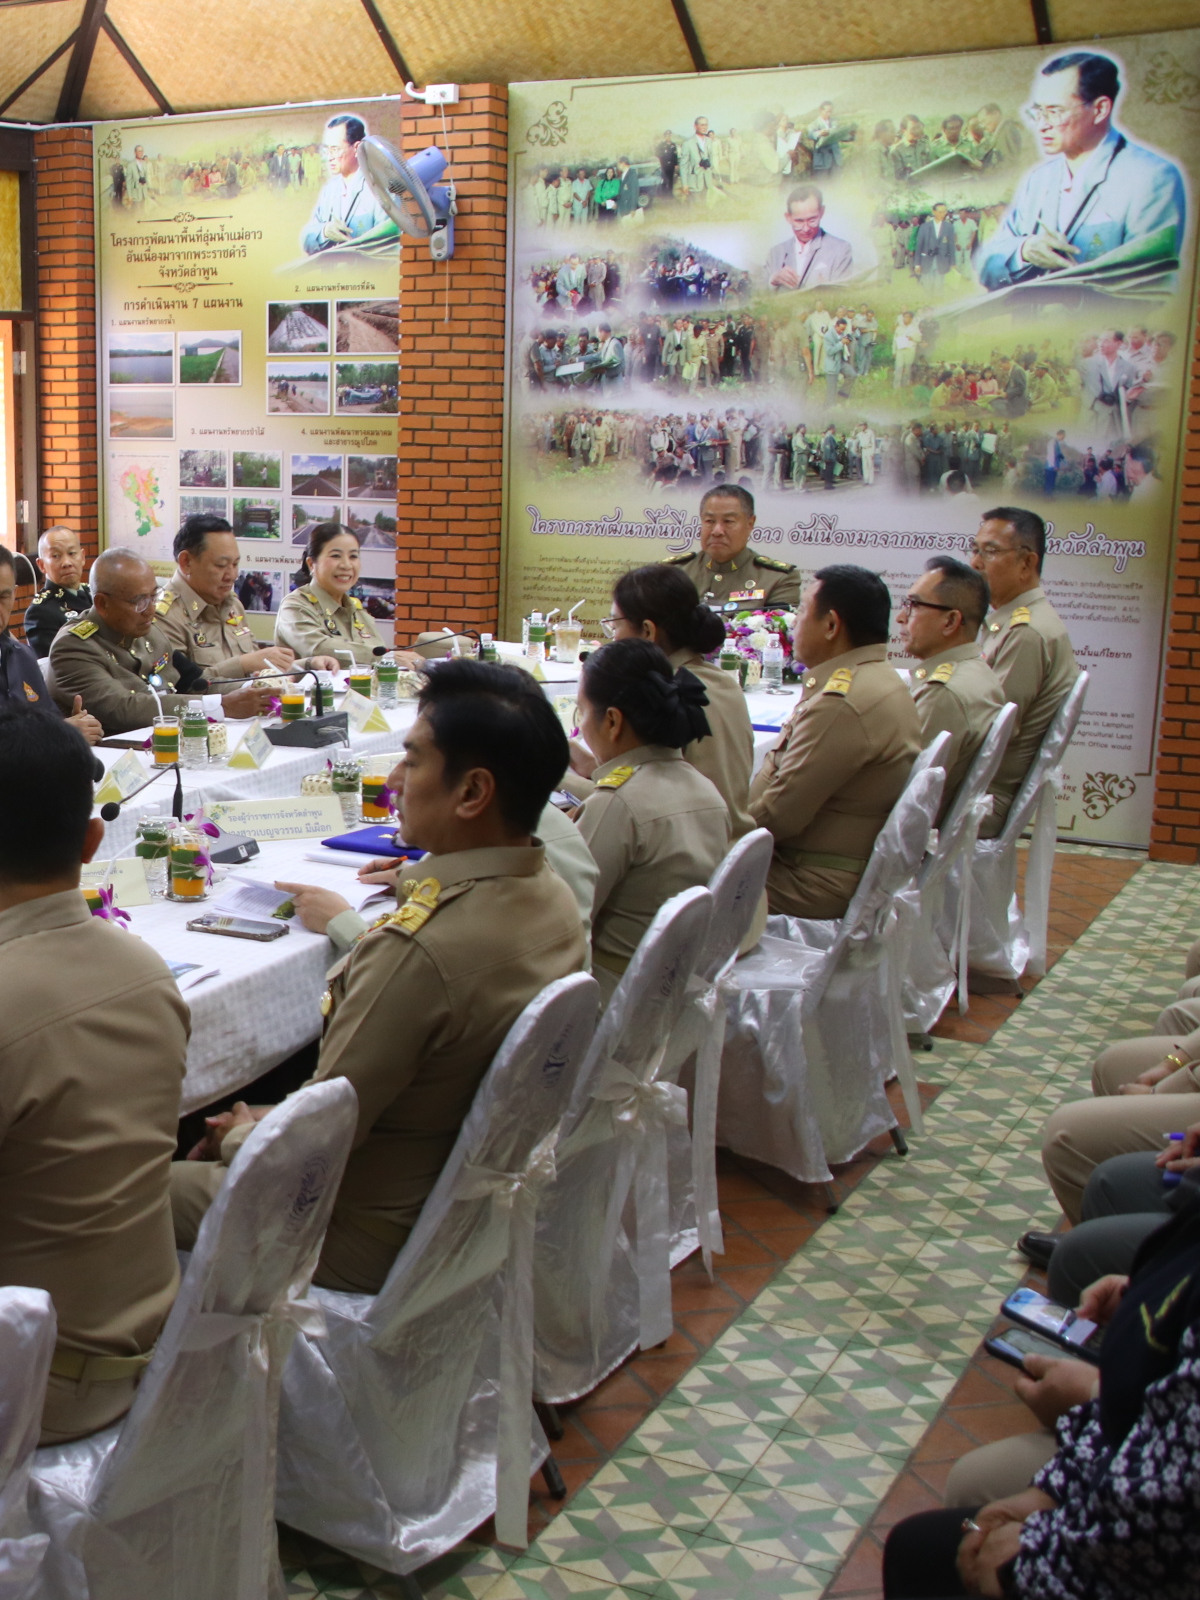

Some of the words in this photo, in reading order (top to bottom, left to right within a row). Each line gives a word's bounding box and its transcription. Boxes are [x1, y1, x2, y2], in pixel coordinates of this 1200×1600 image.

[110, 224, 263, 247] โครงการพัฒนาพื้นที่ลุ่มน้ำแม่อาว
[126, 244, 247, 263] อันเนื่องมาจากพระราชดำริ
[158, 264, 218, 280] จังหวัดลำพูน
[123, 297, 188, 311] การดำเนินงาน
[192, 298, 199, 309] 7
[203, 297, 244, 309] แผนงาน
[1080, 709, 1108, 717] sources
[1101, 721, 1134, 729] Lamphun
[1076, 730, 1114, 738] Agricultural
[1115, 732, 1133, 740] Land
[1111, 743, 1132, 751] would
[228, 808, 323, 824] รองผู้ว่าราชการจังหวัดลำพูน
[227, 826, 303, 838] างสาวเบญจวรรณ
[305, 822, 332, 834] มีเผือก
